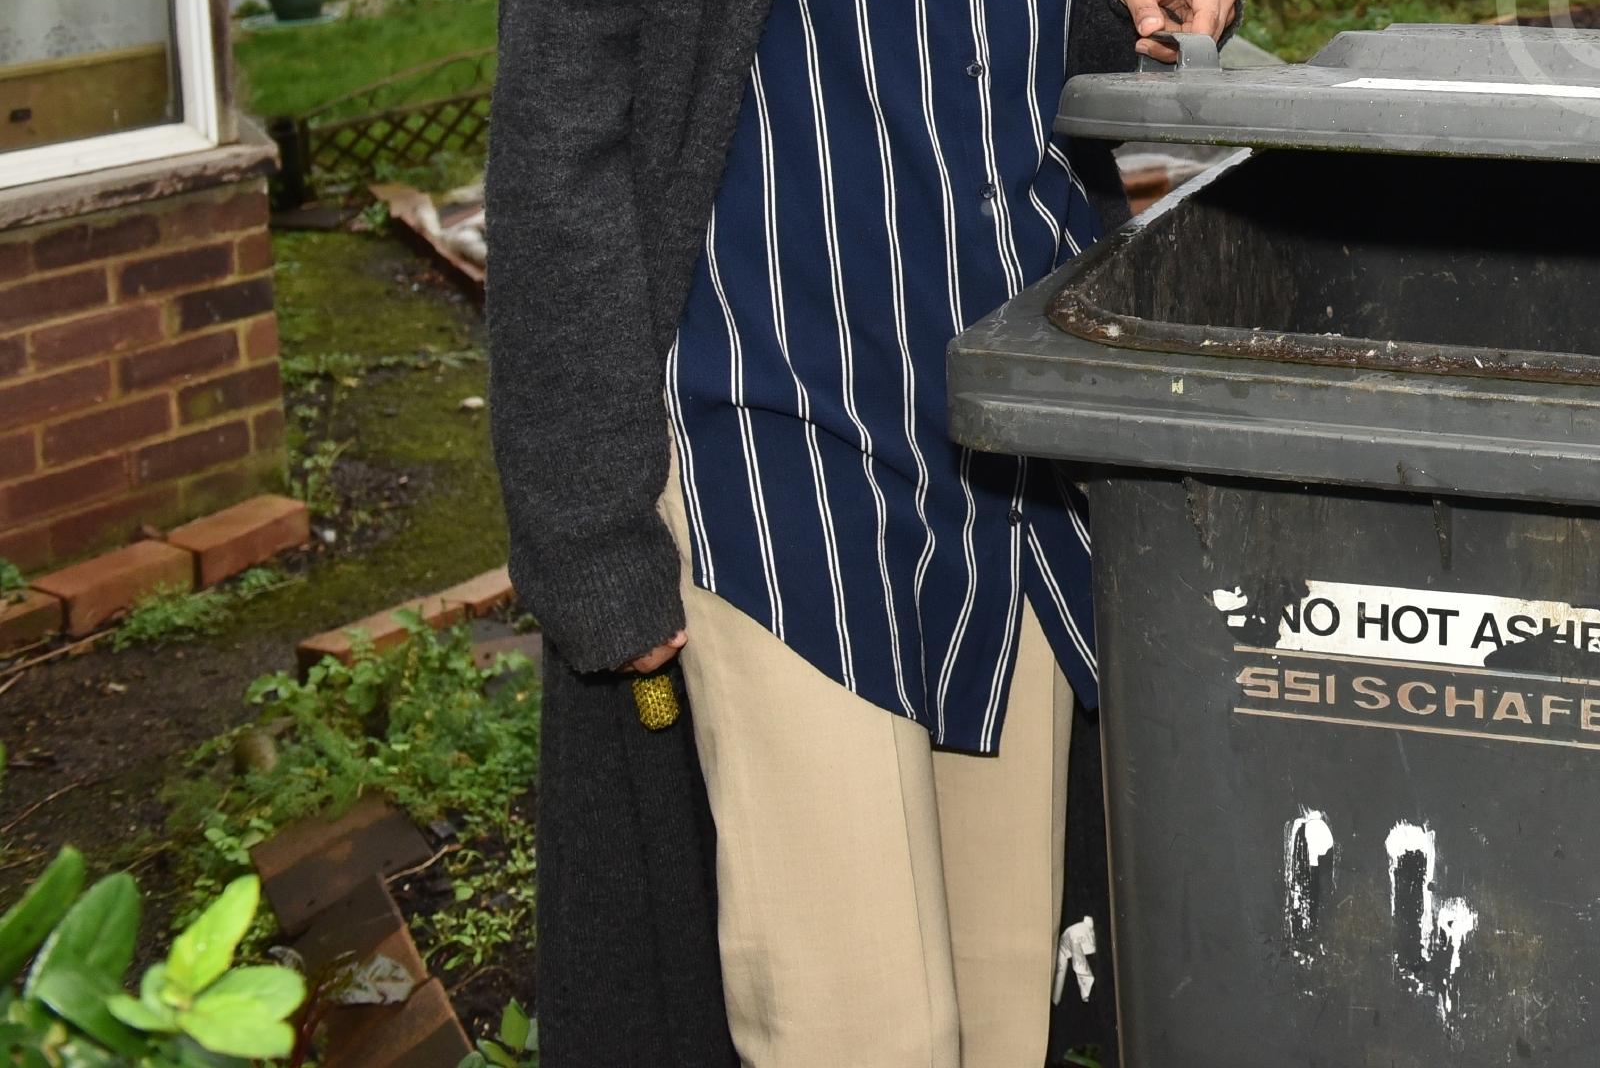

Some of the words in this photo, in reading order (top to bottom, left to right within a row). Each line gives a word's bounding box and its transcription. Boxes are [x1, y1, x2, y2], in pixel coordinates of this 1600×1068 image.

[1281, 597, 1340, 636] NO
[1357, 601, 1459, 644] HOT
[1235, 666, 1335, 705] SSI
